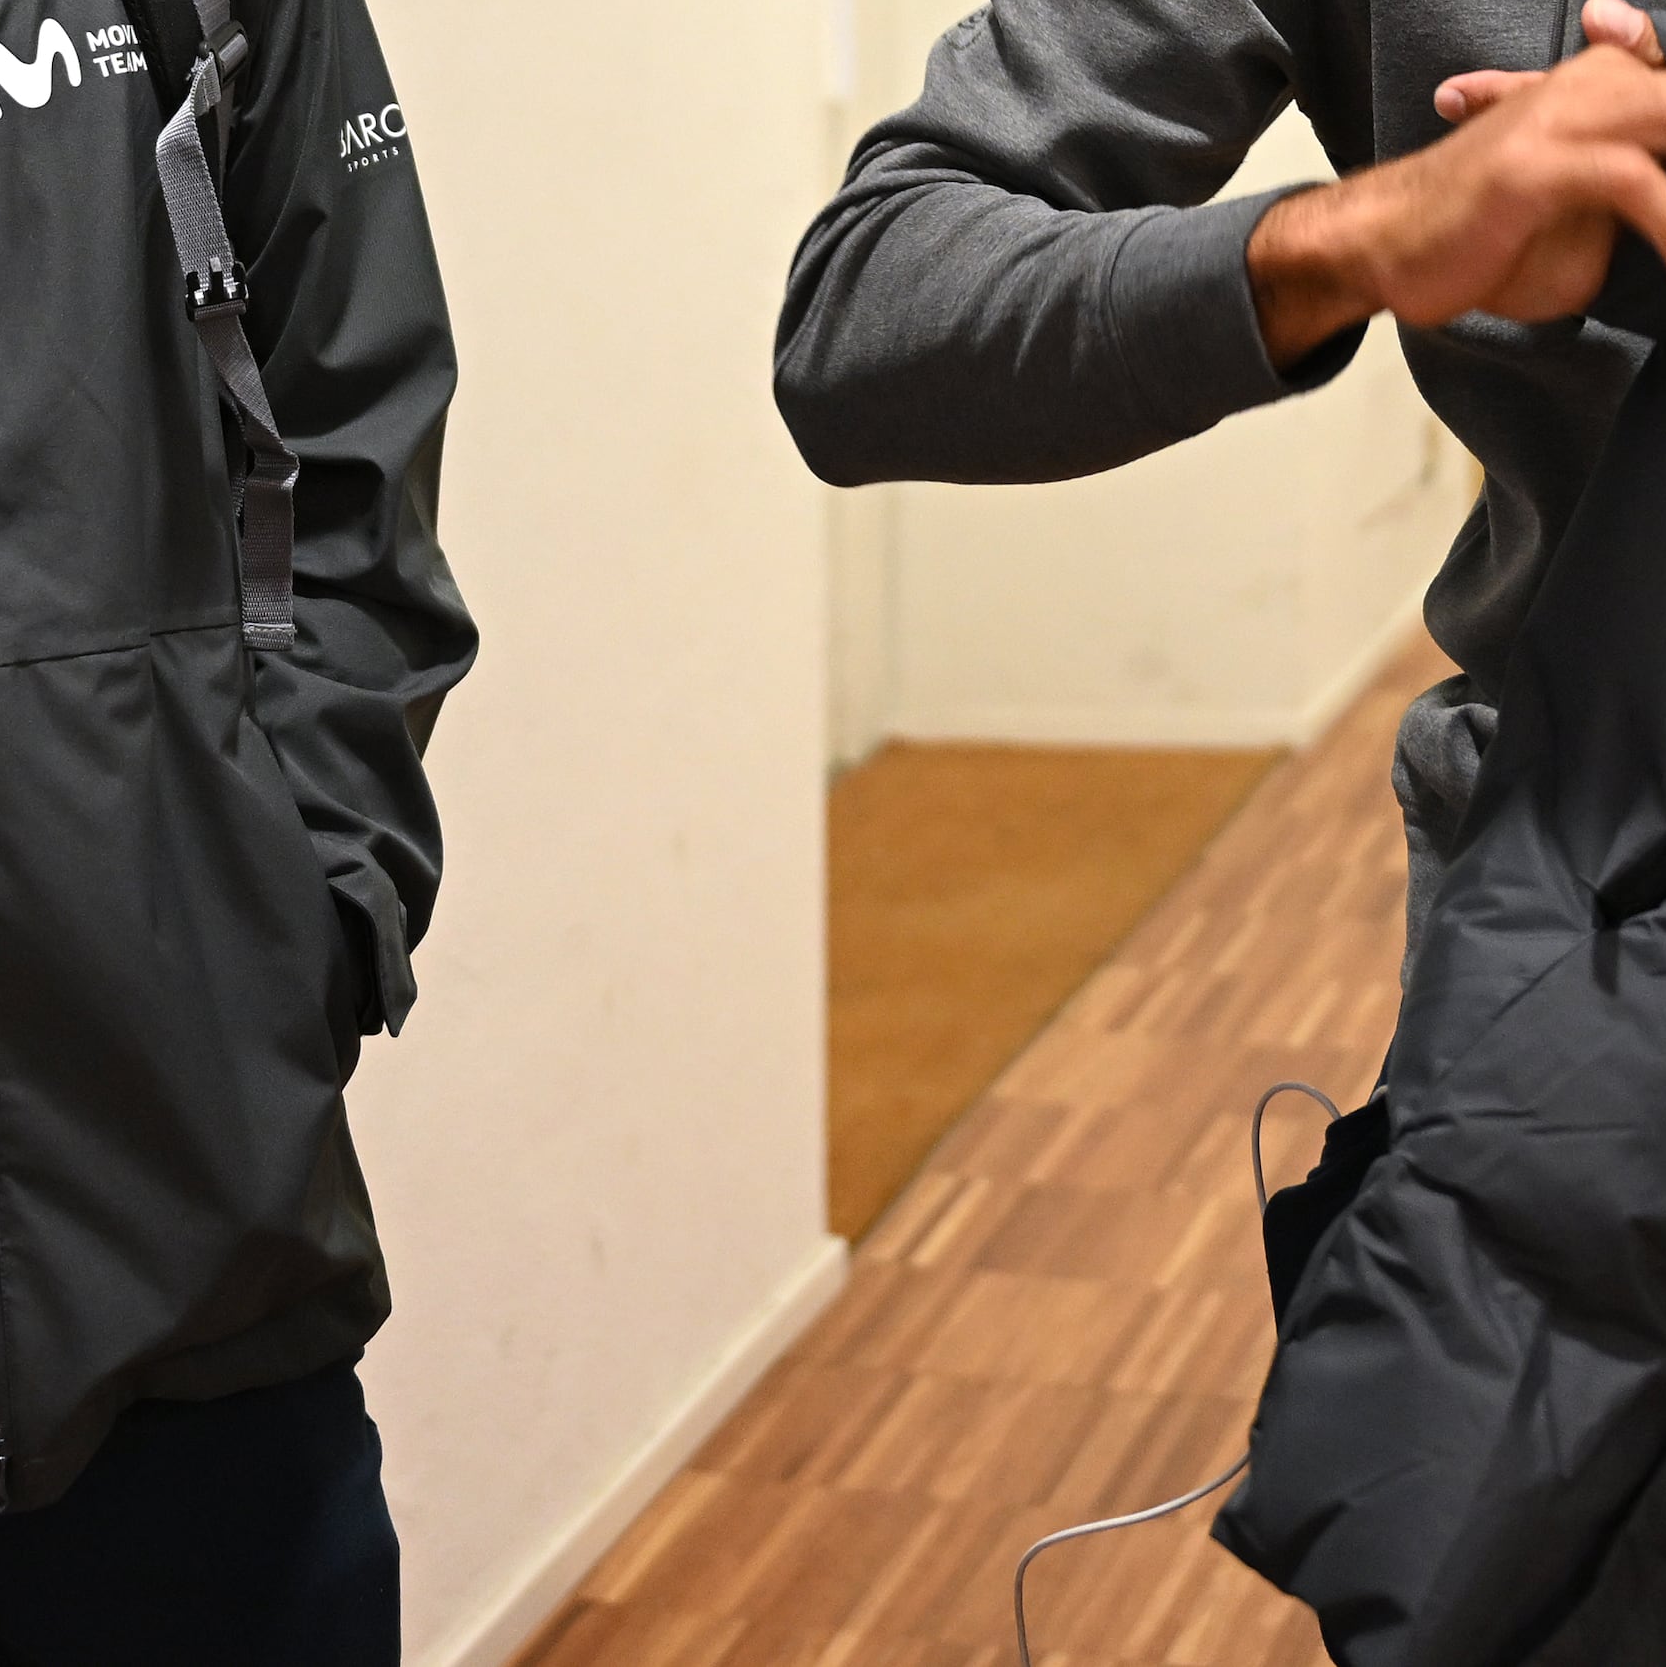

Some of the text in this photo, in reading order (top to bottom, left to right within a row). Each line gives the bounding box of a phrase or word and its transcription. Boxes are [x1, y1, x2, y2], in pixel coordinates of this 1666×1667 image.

[86, 24, 139, 52] MOVI
[92, 51, 148, 78] TEAM
[348, 146, 399, 172] SPORTS
